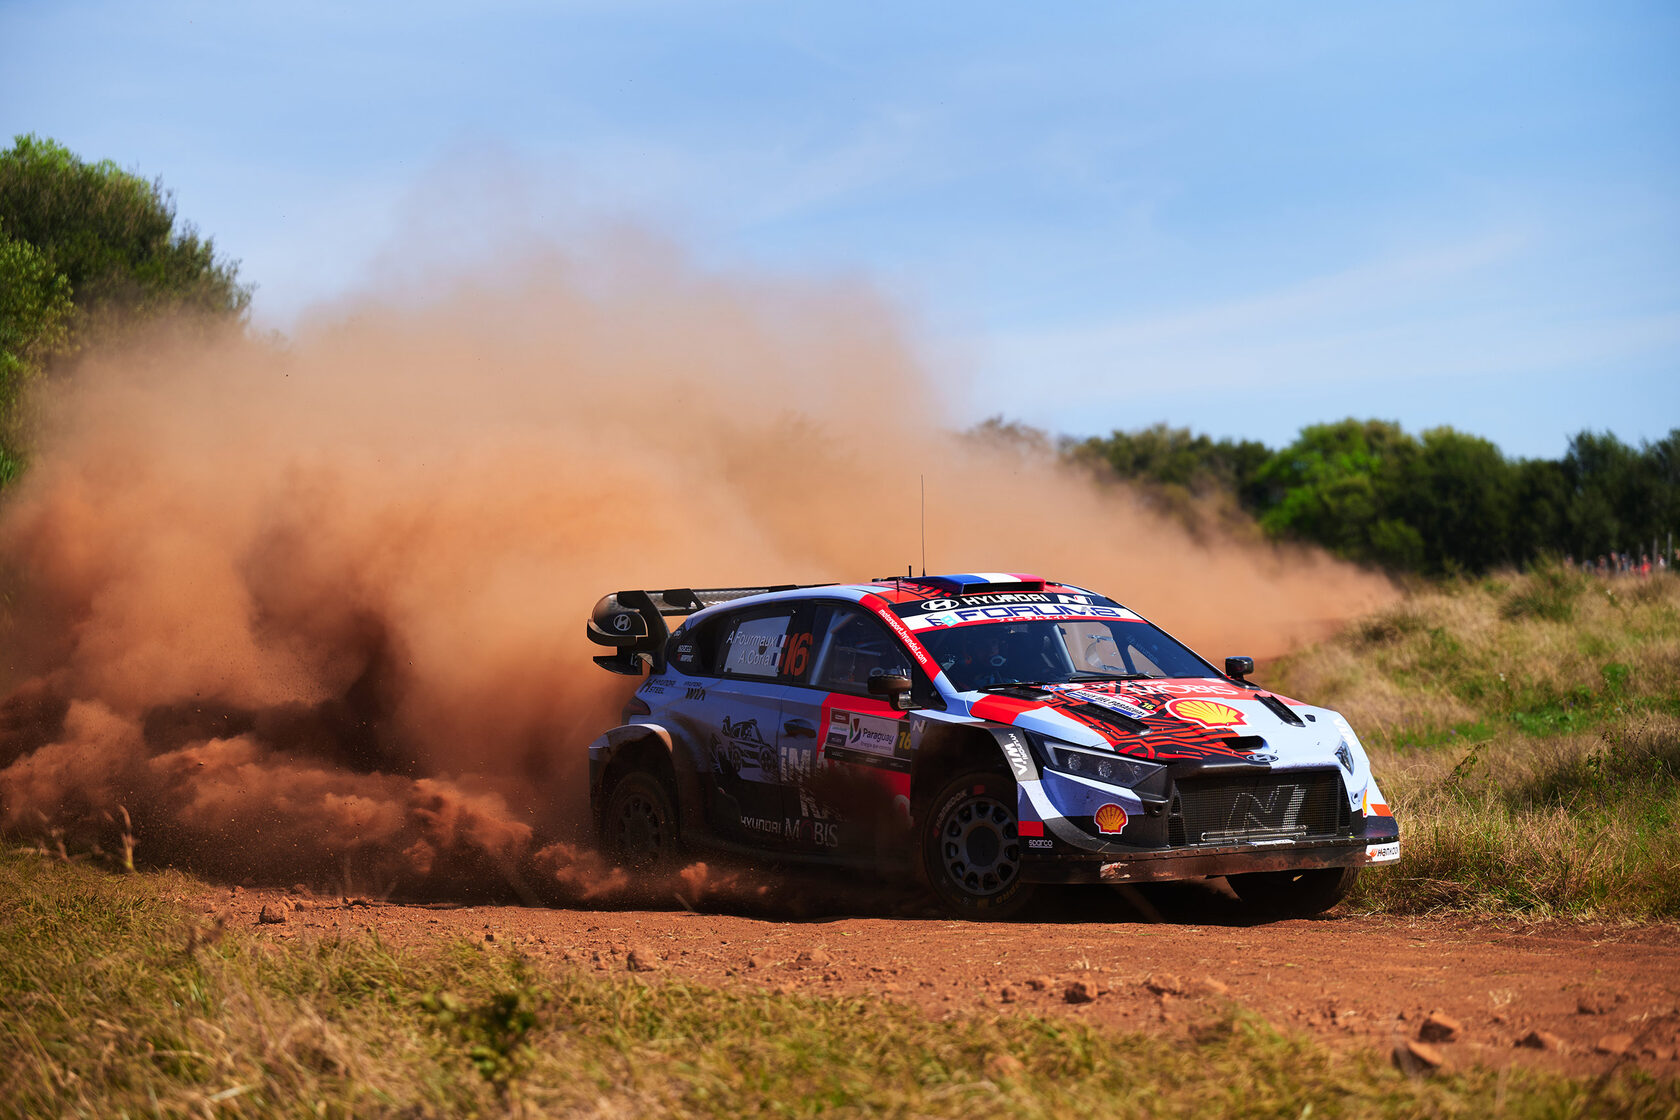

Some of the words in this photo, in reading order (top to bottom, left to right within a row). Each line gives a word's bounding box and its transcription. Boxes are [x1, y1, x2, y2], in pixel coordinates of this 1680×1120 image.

[962, 593, 1051, 606] HYUNDAI
[955, 605, 1121, 621] FORUM8
[878, 609, 928, 665] motorsport.hyundai.com
[783, 632, 814, 676] 16
[1141, 702, 1156, 711] 16
[862, 728, 895, 745] Paraguay
[898, 731, 912, 750] 16
[1028, 839, 1054, 848] sparco
